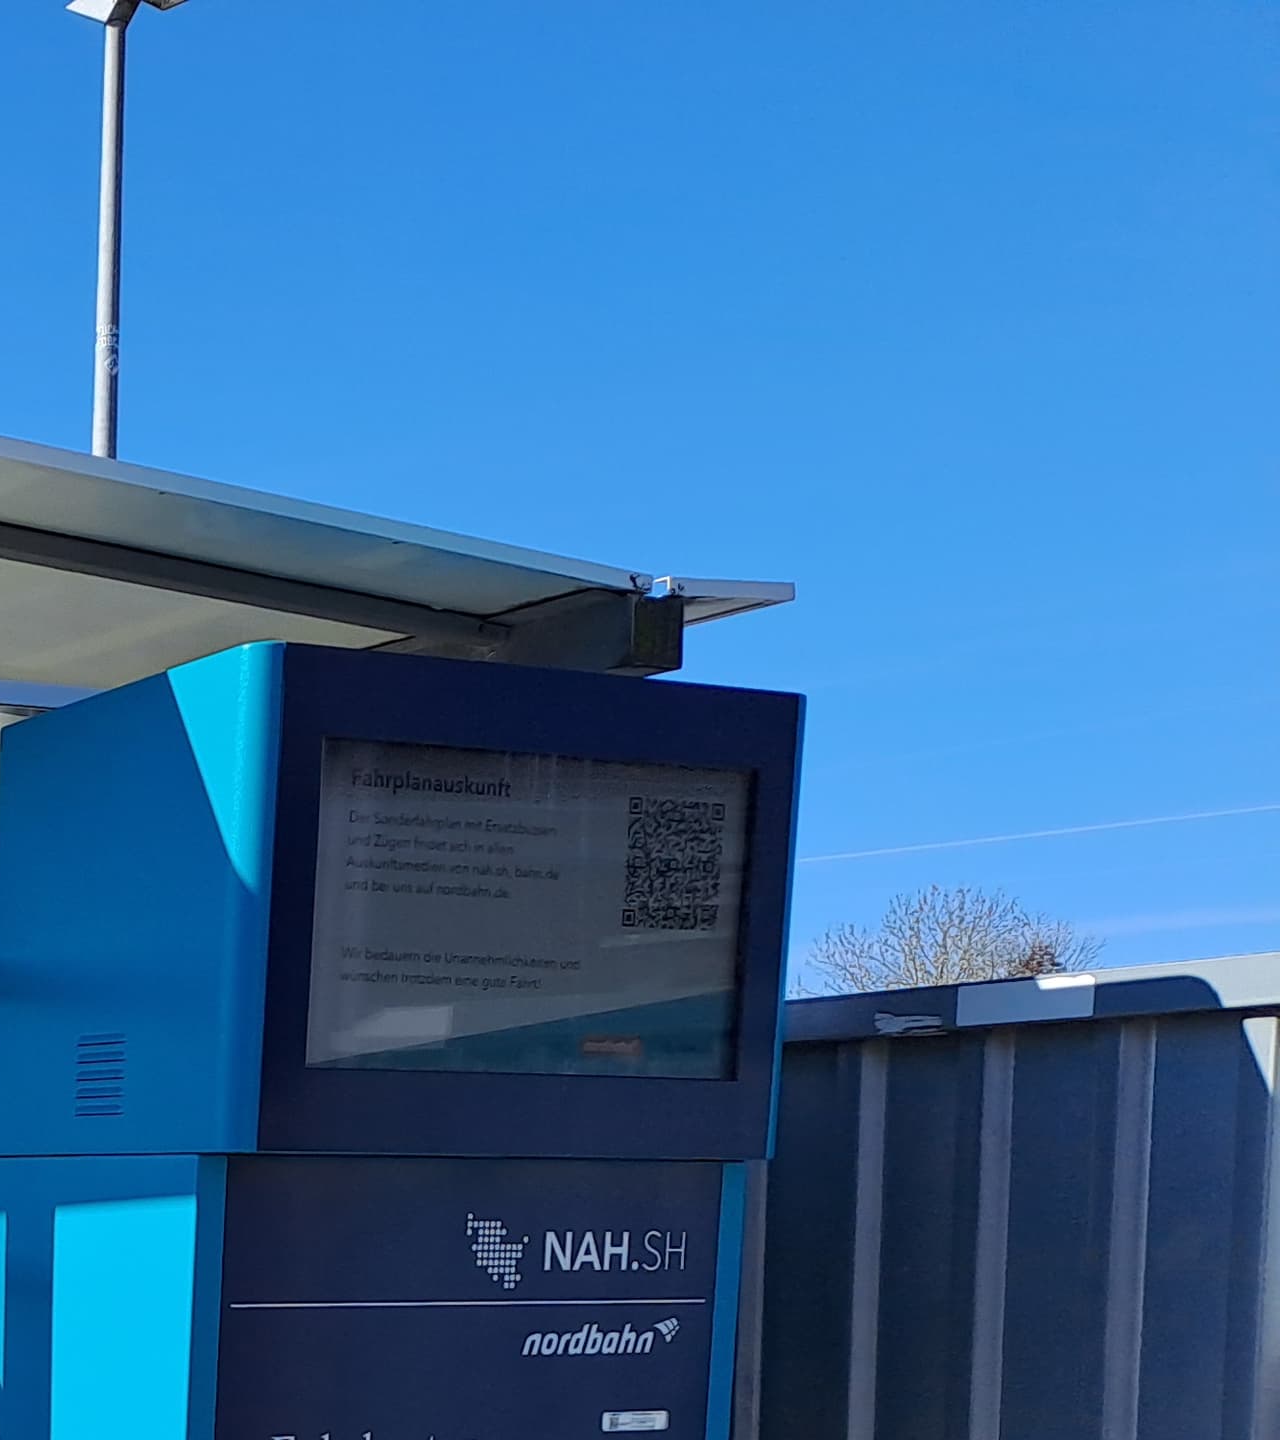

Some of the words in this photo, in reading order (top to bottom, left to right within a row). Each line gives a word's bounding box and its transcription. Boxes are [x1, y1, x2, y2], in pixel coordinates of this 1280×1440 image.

[351, 770, 512, 798] Fahrplanauskunft
[543, 1229, 687, 1272] NAH.SH
[521, 1323, 655, 1356] nordbahn
